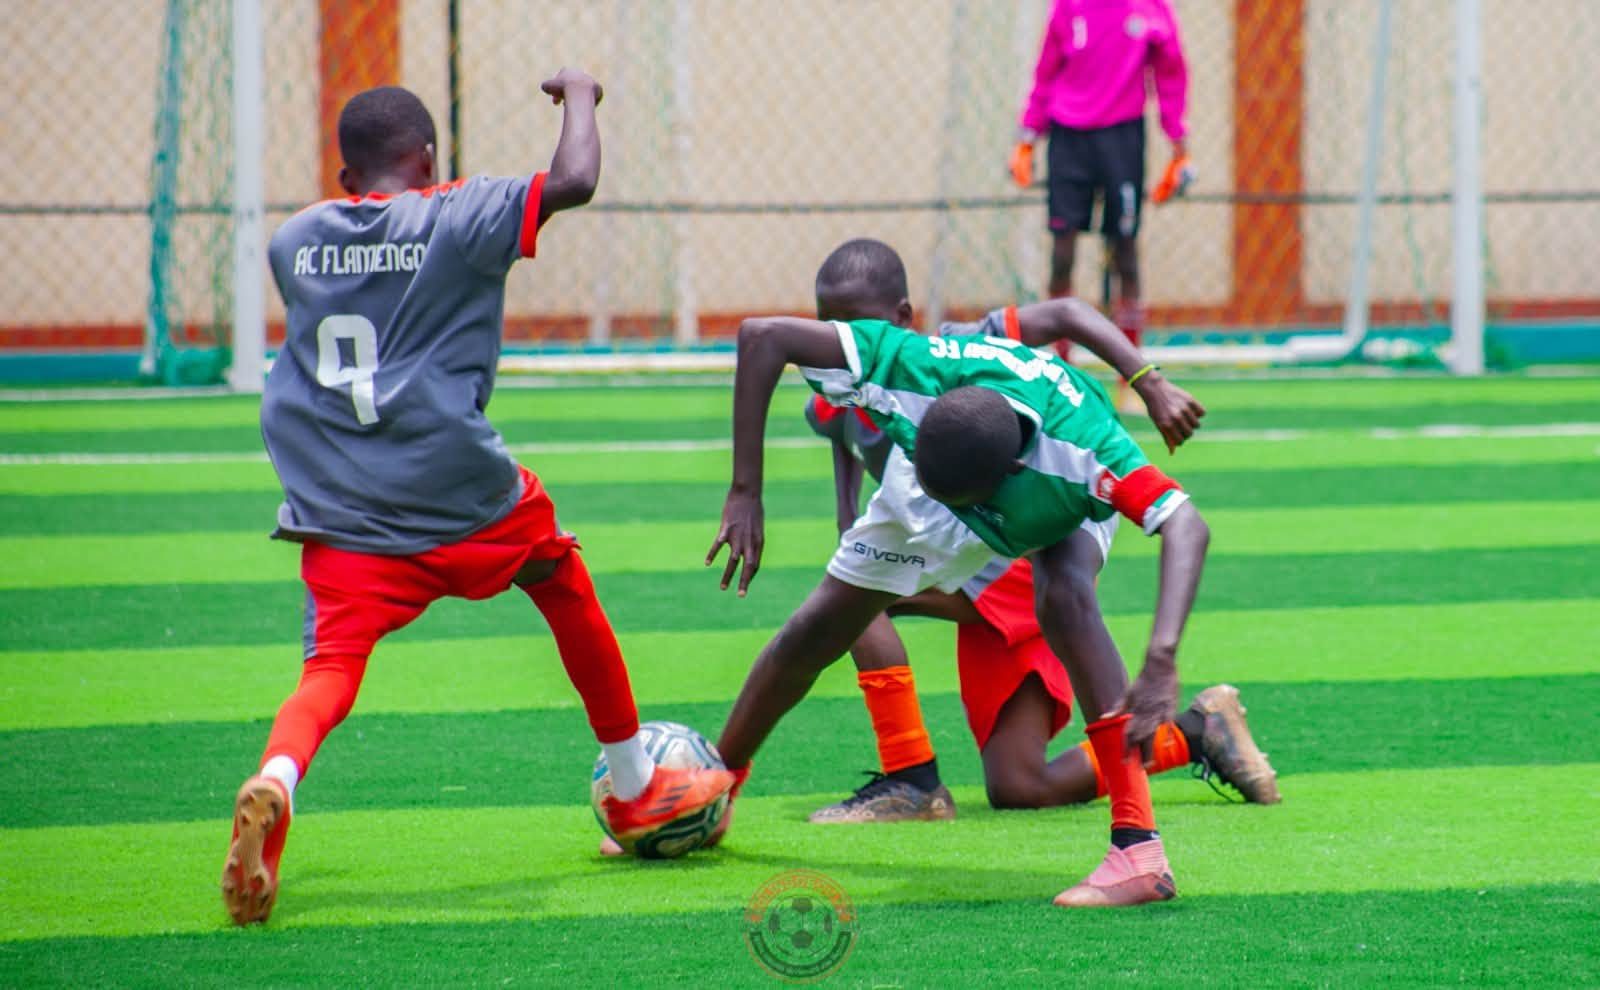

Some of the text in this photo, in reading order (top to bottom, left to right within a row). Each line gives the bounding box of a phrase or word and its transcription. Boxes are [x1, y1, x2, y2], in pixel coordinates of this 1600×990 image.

[294, 242, 427, 275] AC FLAMENGO
[927, 335, 961, 360] FC
[316, 313, 380, 426] 9
[853, 541, 926, 569] GIVOVA
